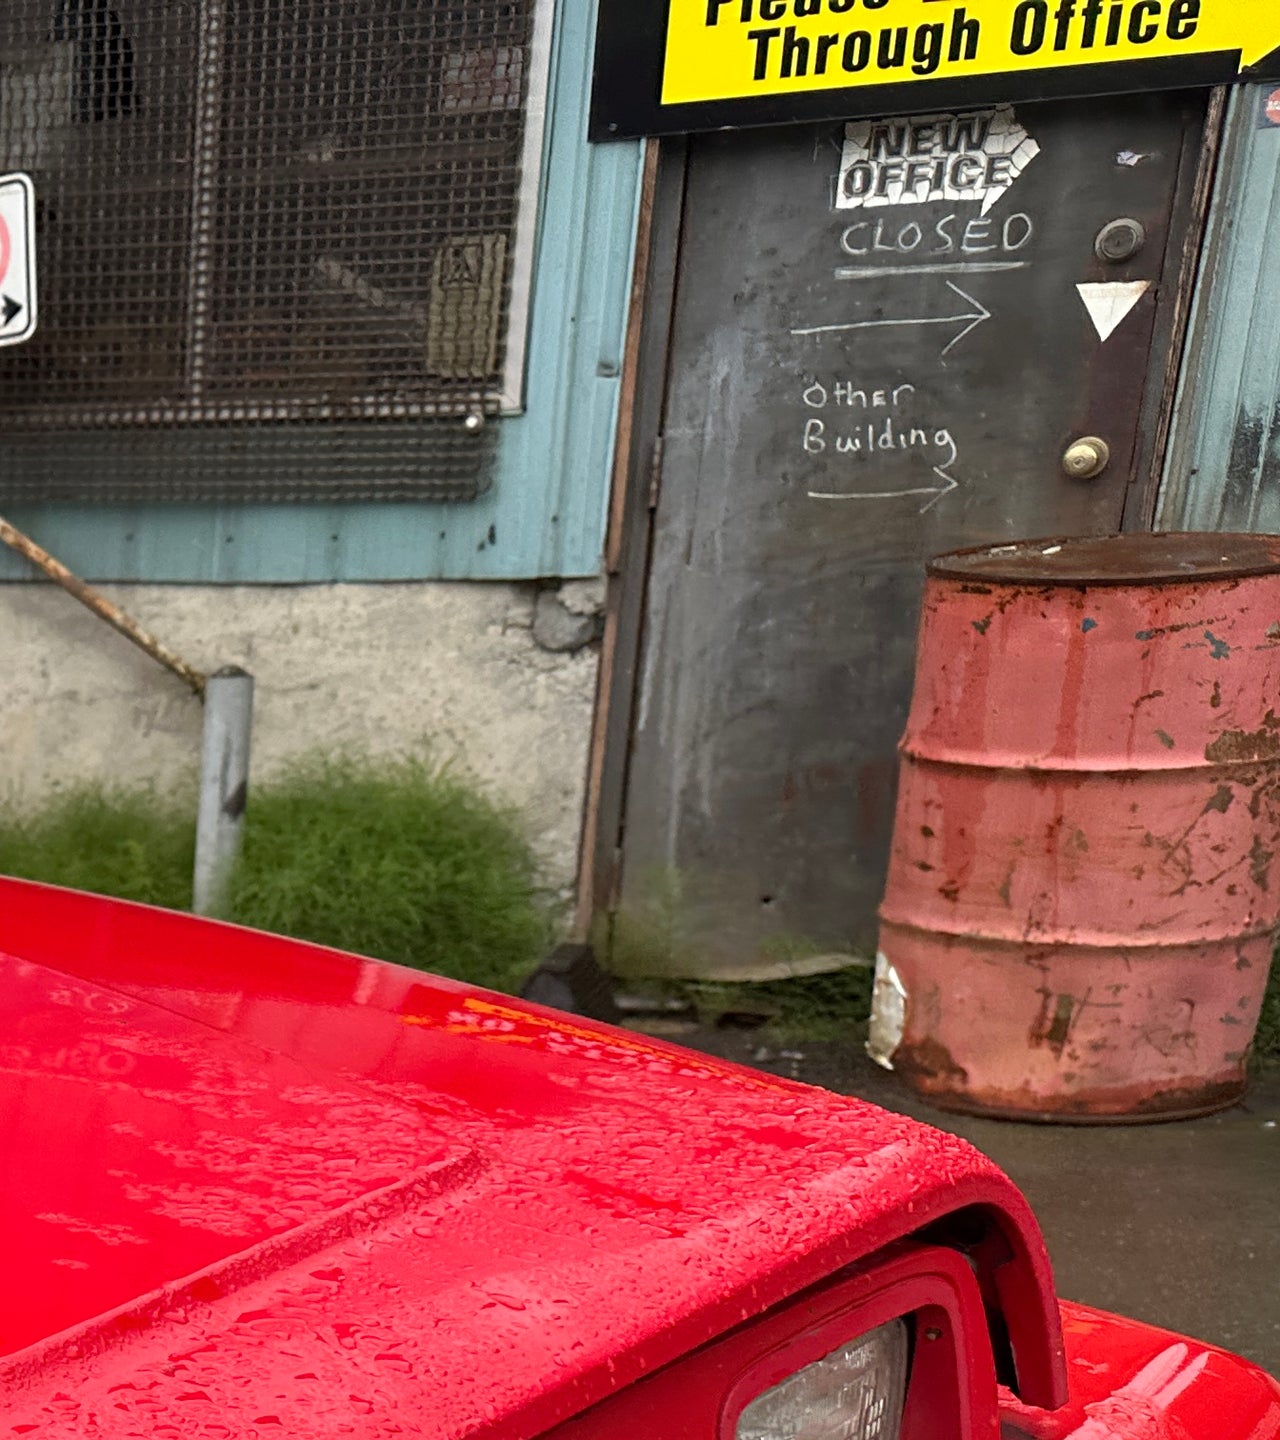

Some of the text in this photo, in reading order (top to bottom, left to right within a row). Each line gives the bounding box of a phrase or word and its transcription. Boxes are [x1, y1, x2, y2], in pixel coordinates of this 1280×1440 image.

[747, 0, 1202, 76] Through Office
[871, 112, 989, 158] NEW
[842, 154, 1013, 198] OFFICE
[842, 212, 1033, 256] CLOSED
[803, 417, 958, 469] Building
